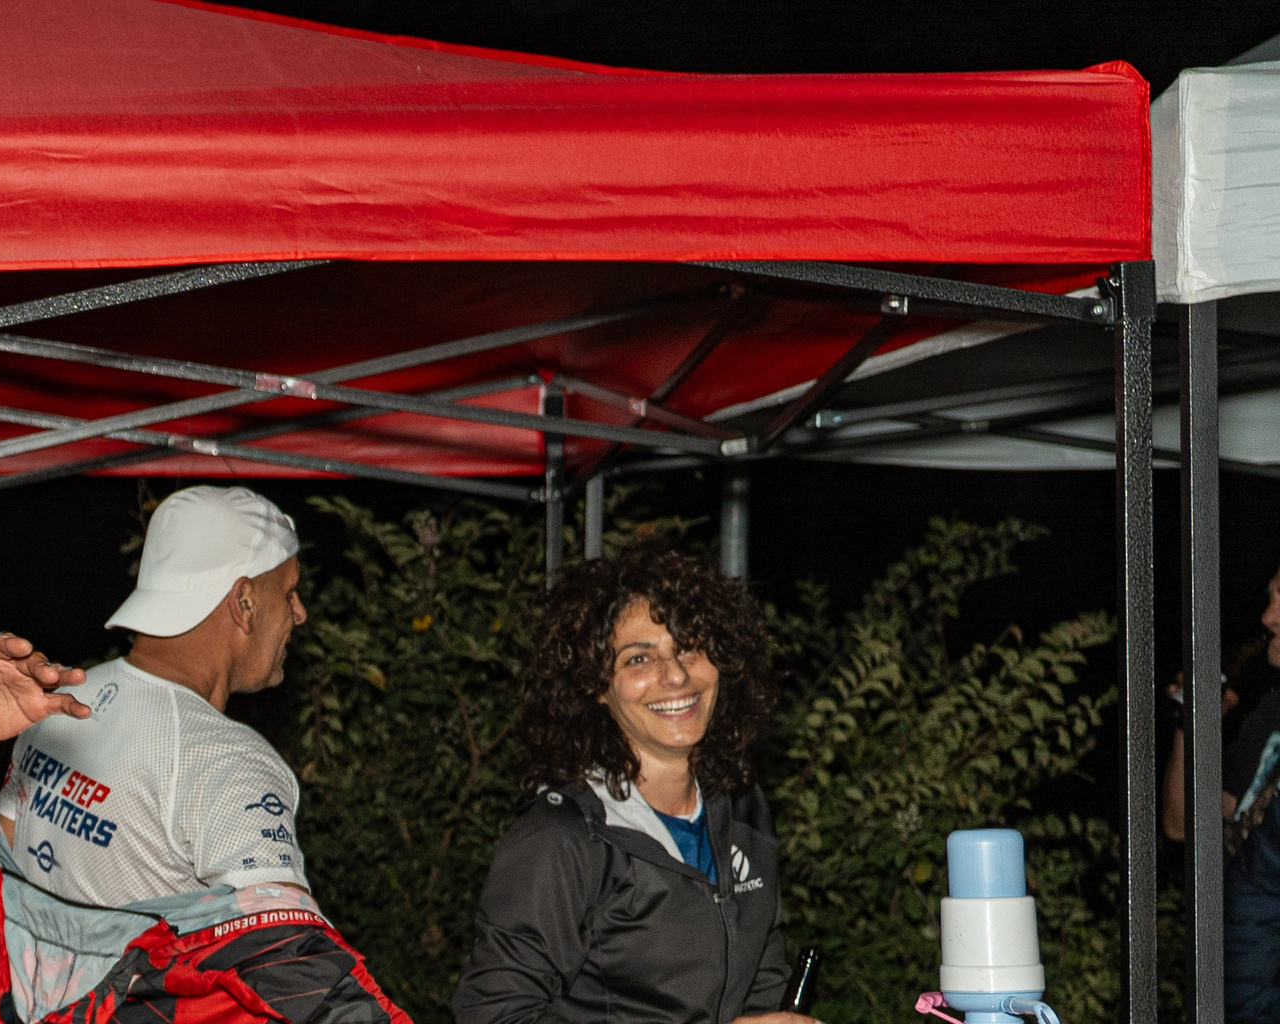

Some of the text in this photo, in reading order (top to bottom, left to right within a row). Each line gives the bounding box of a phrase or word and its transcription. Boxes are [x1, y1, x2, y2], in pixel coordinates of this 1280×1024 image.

[61, 770, 111, 809] STEP
[29, 785, 117, 848] MATTERS
[214, 915, 257, 937] DESIGN
[260, 911, 313, 924] UNIQUE
